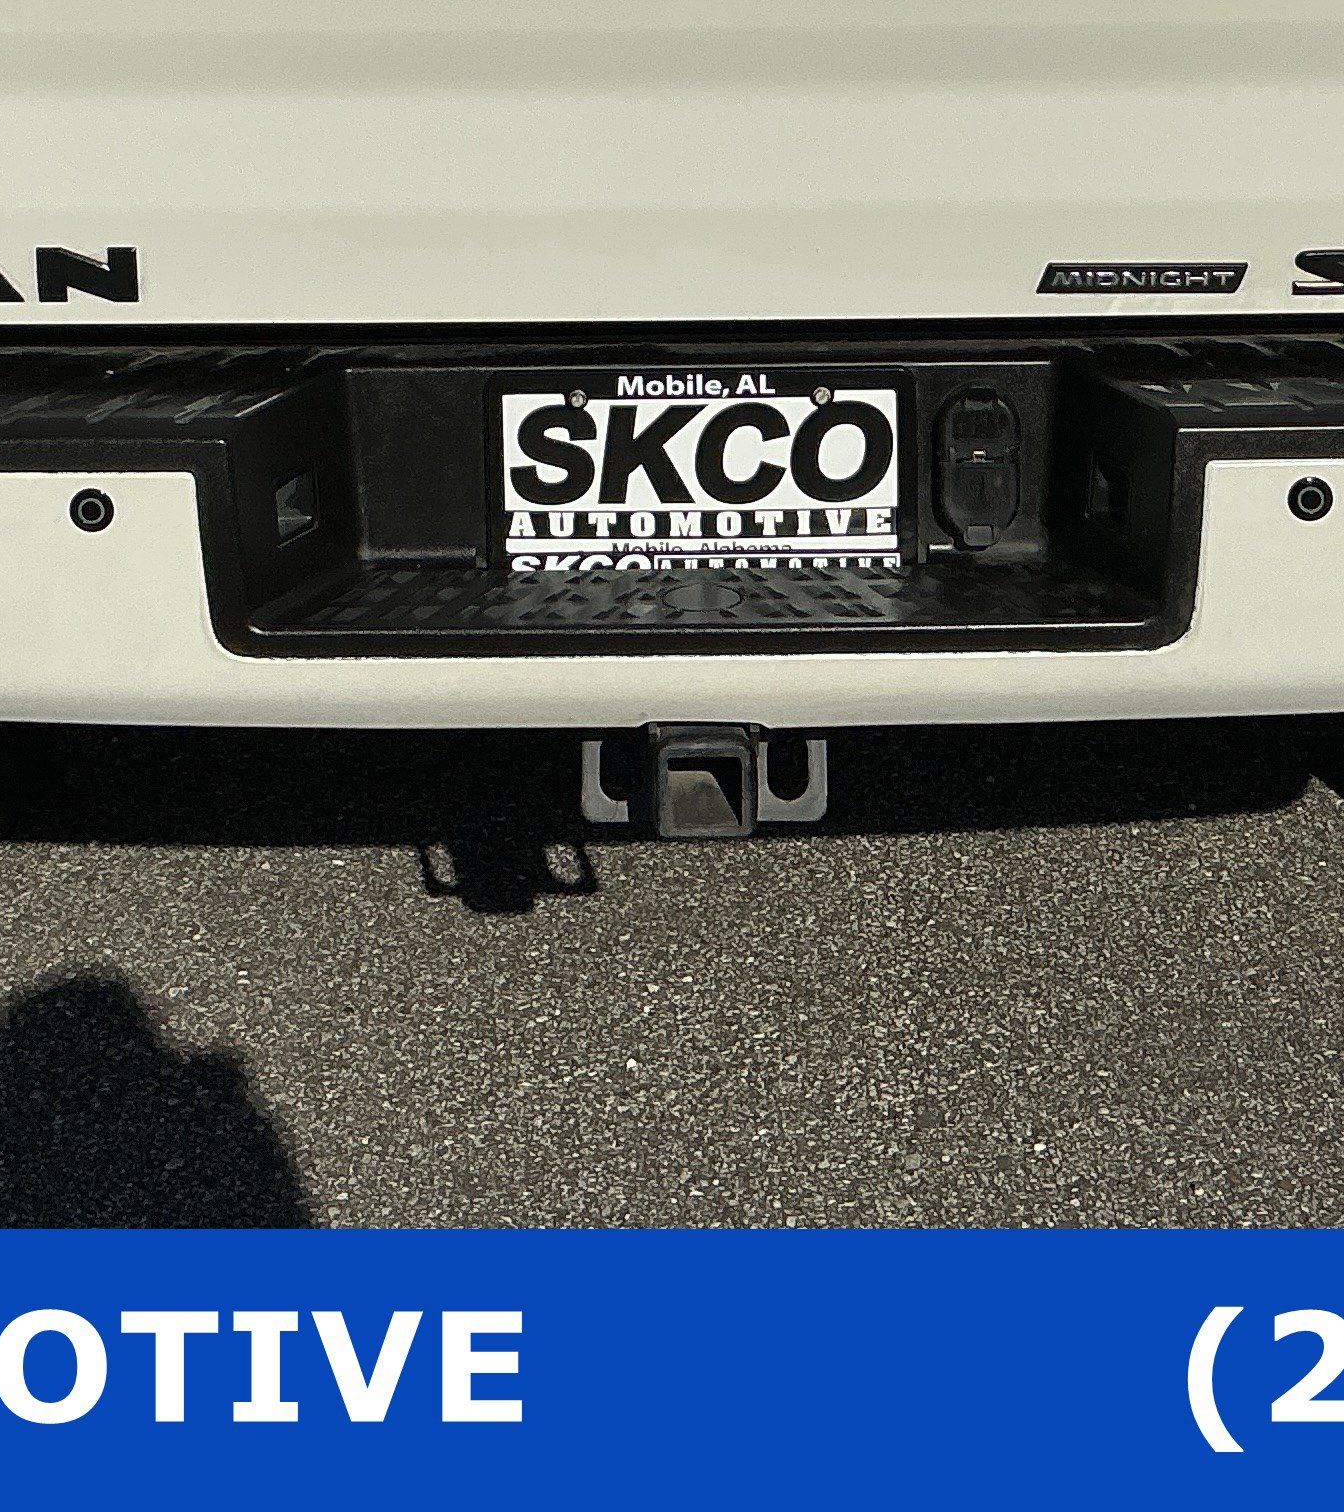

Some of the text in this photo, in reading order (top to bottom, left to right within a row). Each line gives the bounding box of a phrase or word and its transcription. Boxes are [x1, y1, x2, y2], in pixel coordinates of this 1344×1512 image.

[1049, 267, 1235, 290] MIDNIGHT
[616, 373, 776, 399] Mobile, AL
[509, 399, 895, 507] SKCO
[507, 508, 894, 538] AUTOMOTIVE
